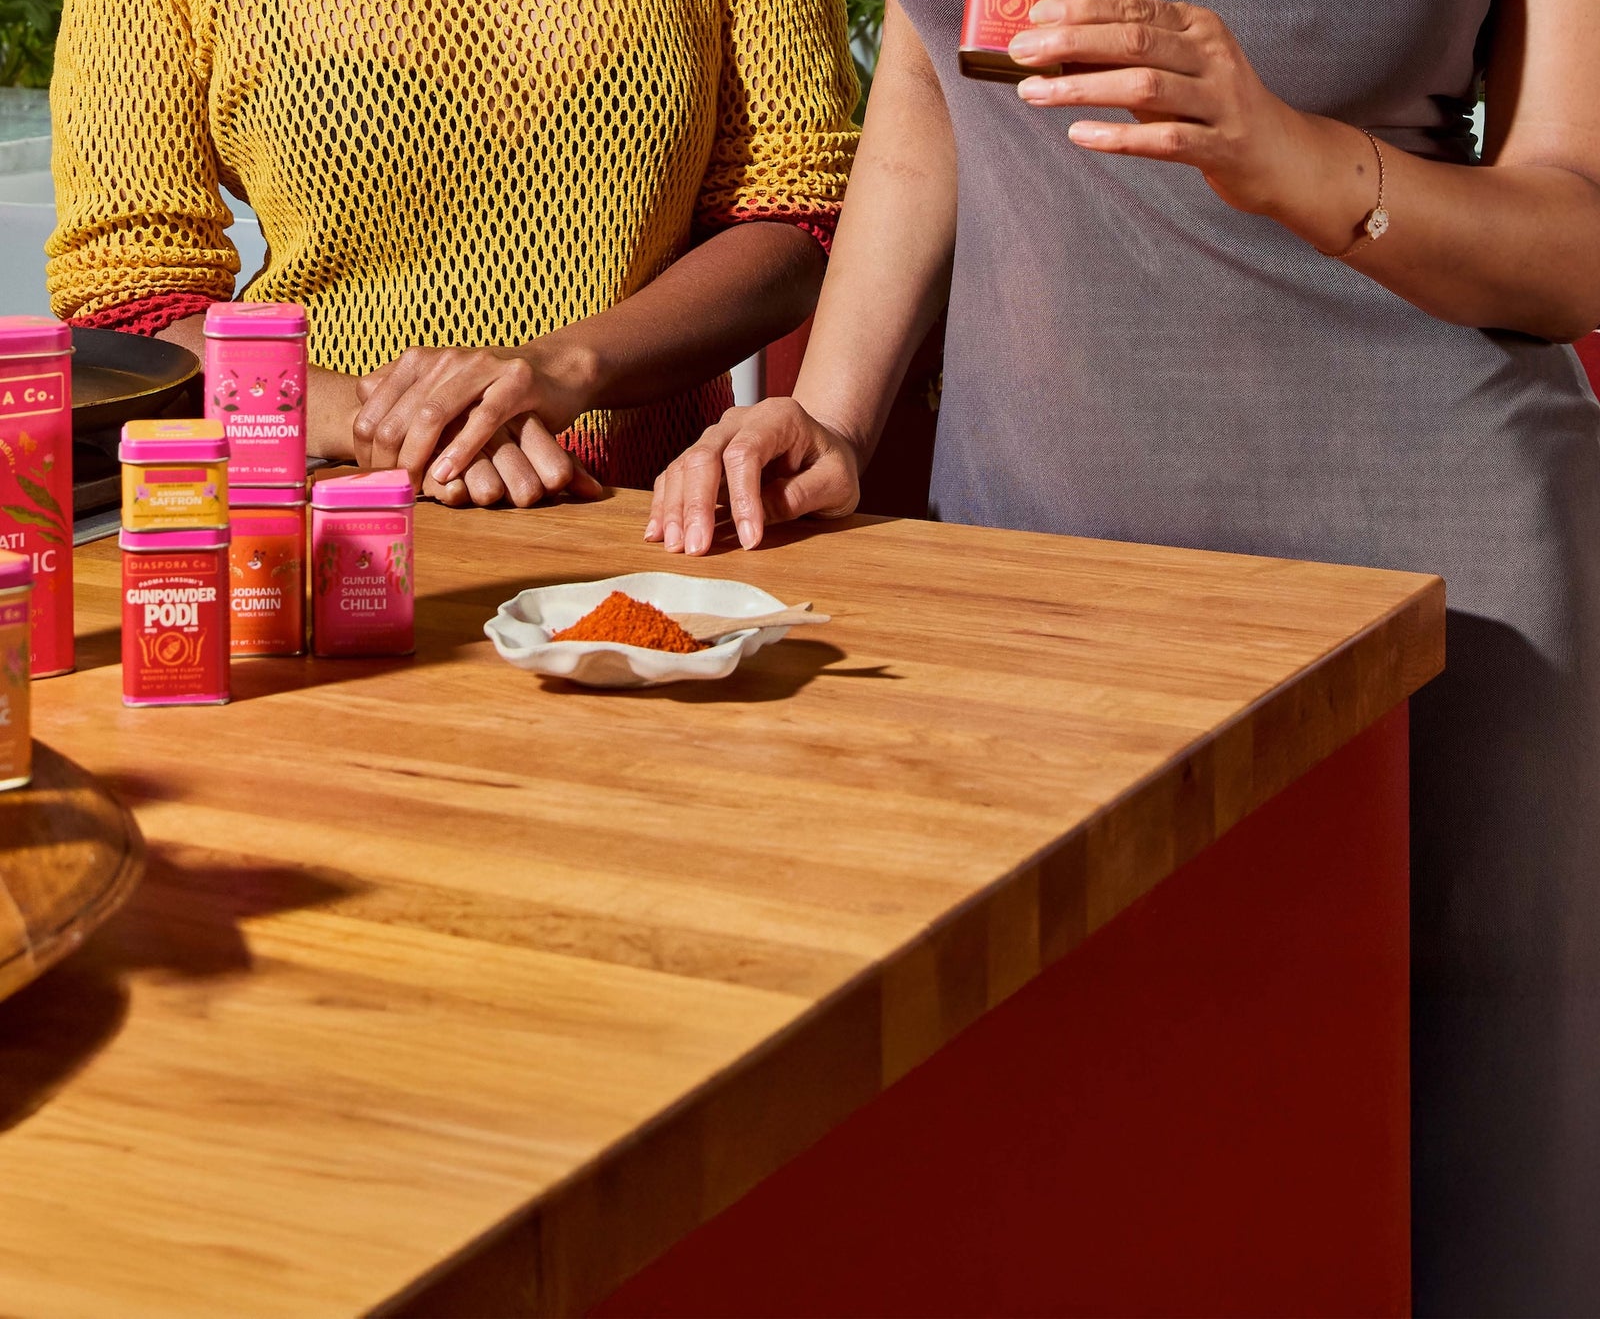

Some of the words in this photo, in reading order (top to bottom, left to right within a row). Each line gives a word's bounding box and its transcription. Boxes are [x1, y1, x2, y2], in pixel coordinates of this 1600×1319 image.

[23, 387, 55, 403] Co.
[230, 414, 255, 424] PENI
[256, 414, 286, 424] MIRIS
[226, 425, 299, 438] INNAMON
[150, 496, 203, 506] SAFFRON
[130, 561, 188, 570] DIASPORA
[342, 576, 386, 585] GUNTUR
[126, 587, 217, 605] GUNPOWDER
[232, 587, 282, 597] JODHANA
[341, 587, 387, 596] SANNAM
[231, 598, 281, 611] CUMIN
[340, 598, 387, 611] CHILLI
[144, 602, 199, 627] PODI
